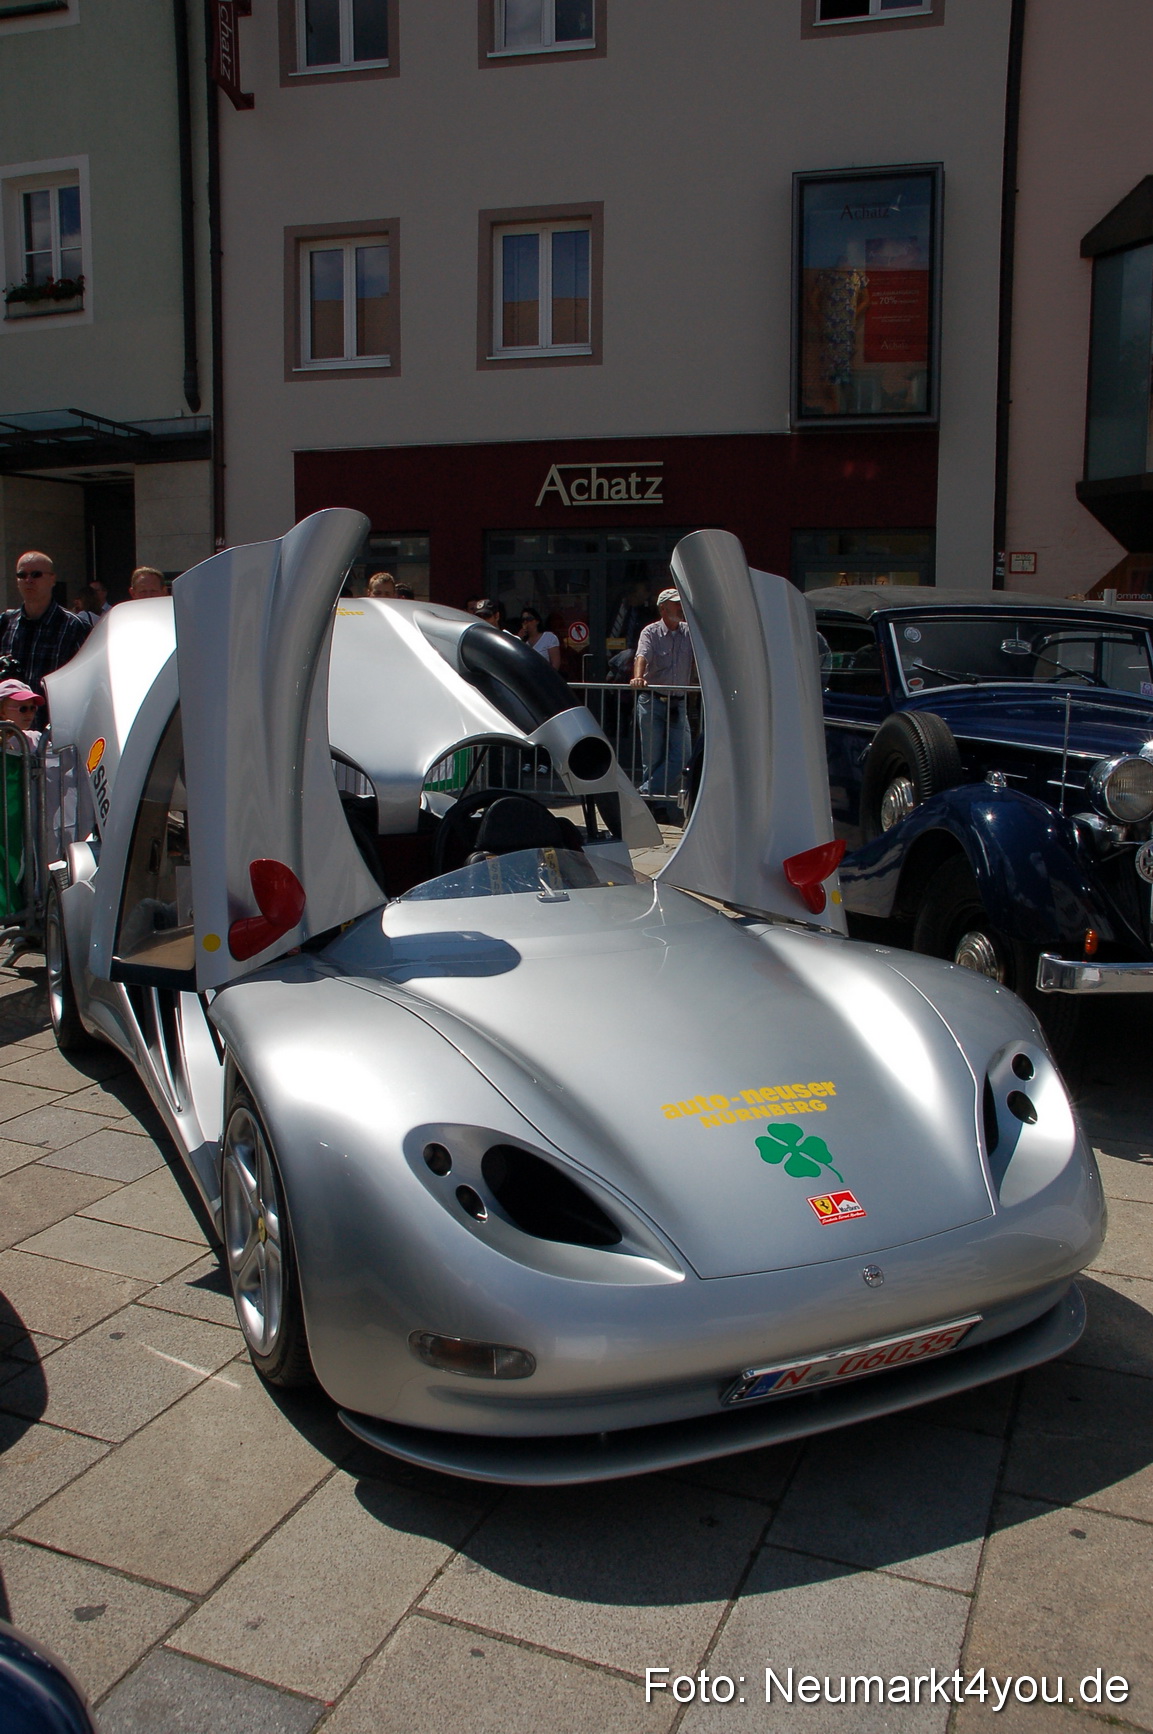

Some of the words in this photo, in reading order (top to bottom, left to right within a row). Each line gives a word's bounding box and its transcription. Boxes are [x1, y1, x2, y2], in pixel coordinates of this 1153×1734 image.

[219, 0, 233, 82] chatz
[840, 203, 890, 220] Achatz
[535, 463, 663, 506] Achatz
[94, 765, 110, 827] She
[660, 1081, 837, 1120] auto-neuser
[699, 1099, 828, 1129] NÜRNBERG
[774, 1366, 812, 1390] N
[836, 1328, 963, 1376] 06035
